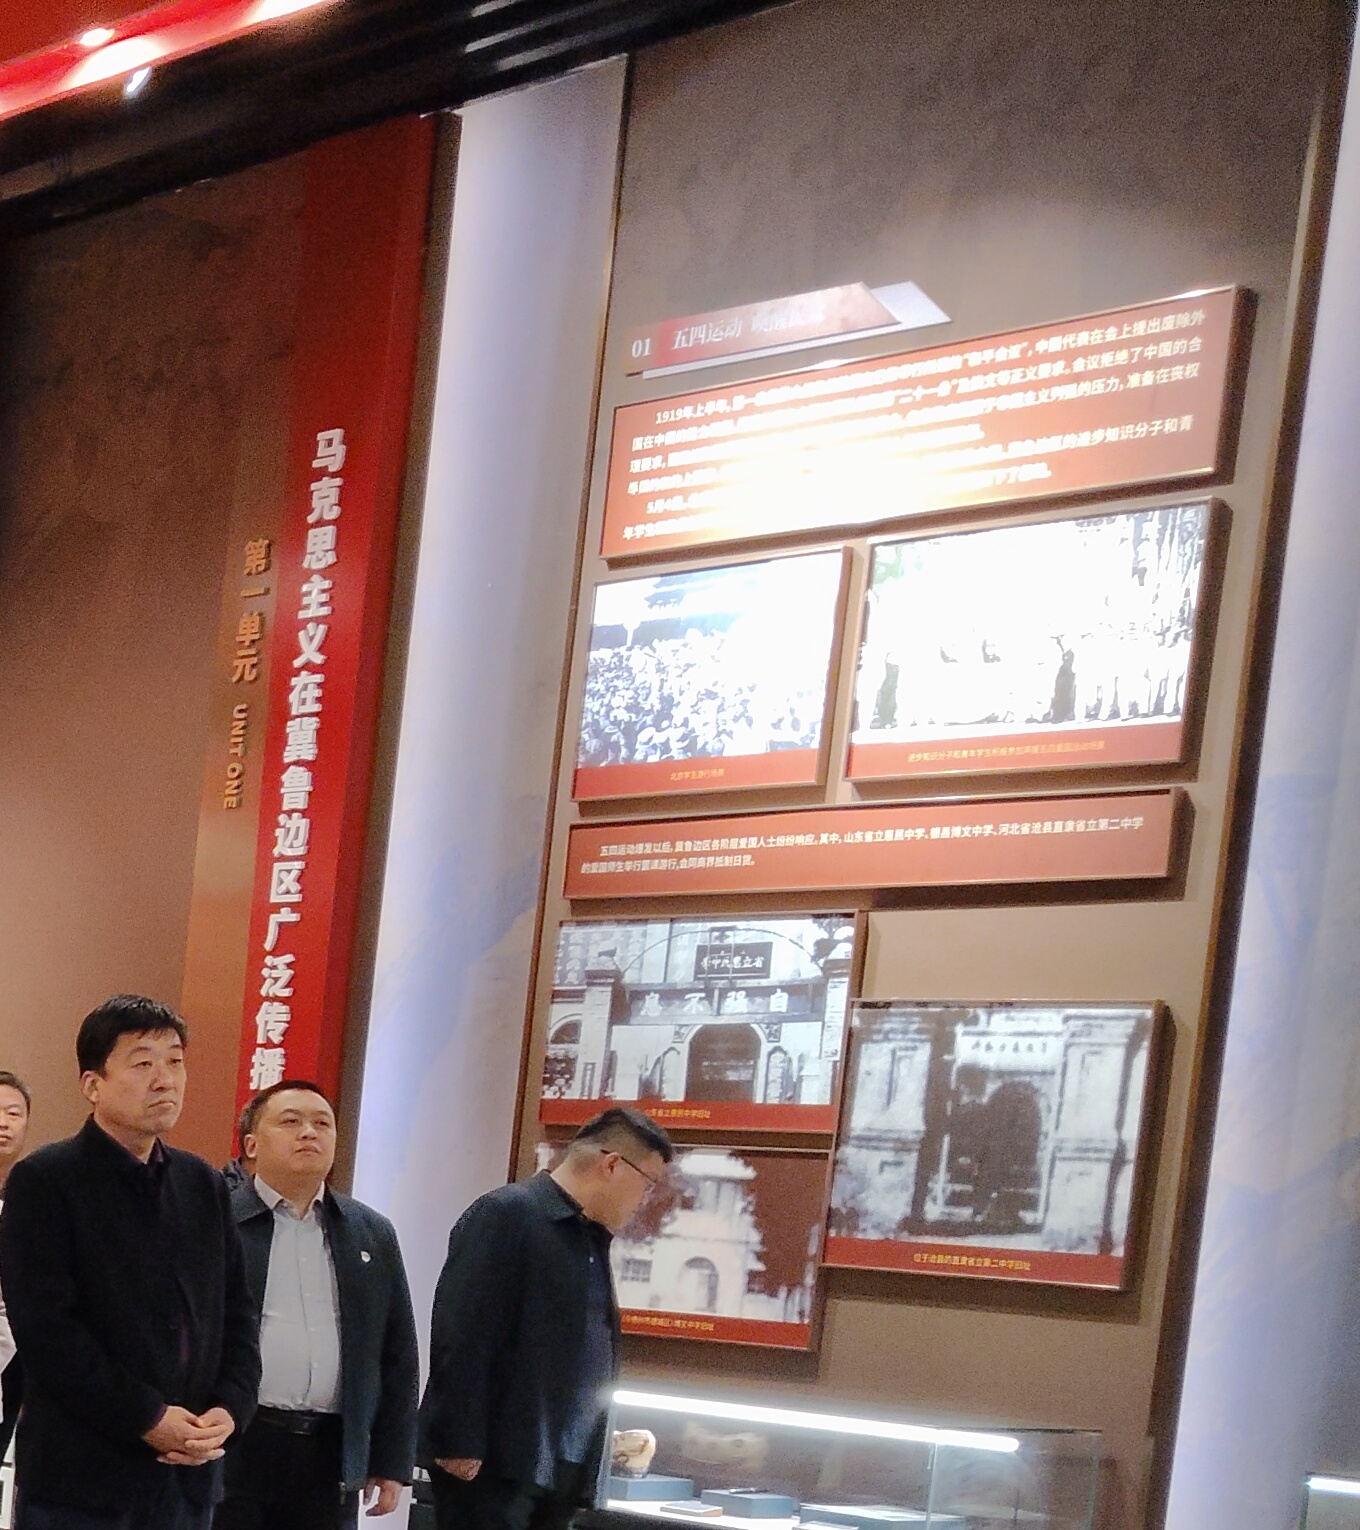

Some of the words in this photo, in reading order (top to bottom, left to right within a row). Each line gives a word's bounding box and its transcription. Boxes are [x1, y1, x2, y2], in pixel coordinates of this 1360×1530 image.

[631, 338, 652, 358] 01
[672, 317, 743, 350] 五四运动
[231, 538, 271, 684] 第一单元
[229, 703, 248, 757] UNIT
[250, 428, 347, 1091] 马克思主义在冀鲁边区广泛传播
[224, 762, 244, 809] ONE
